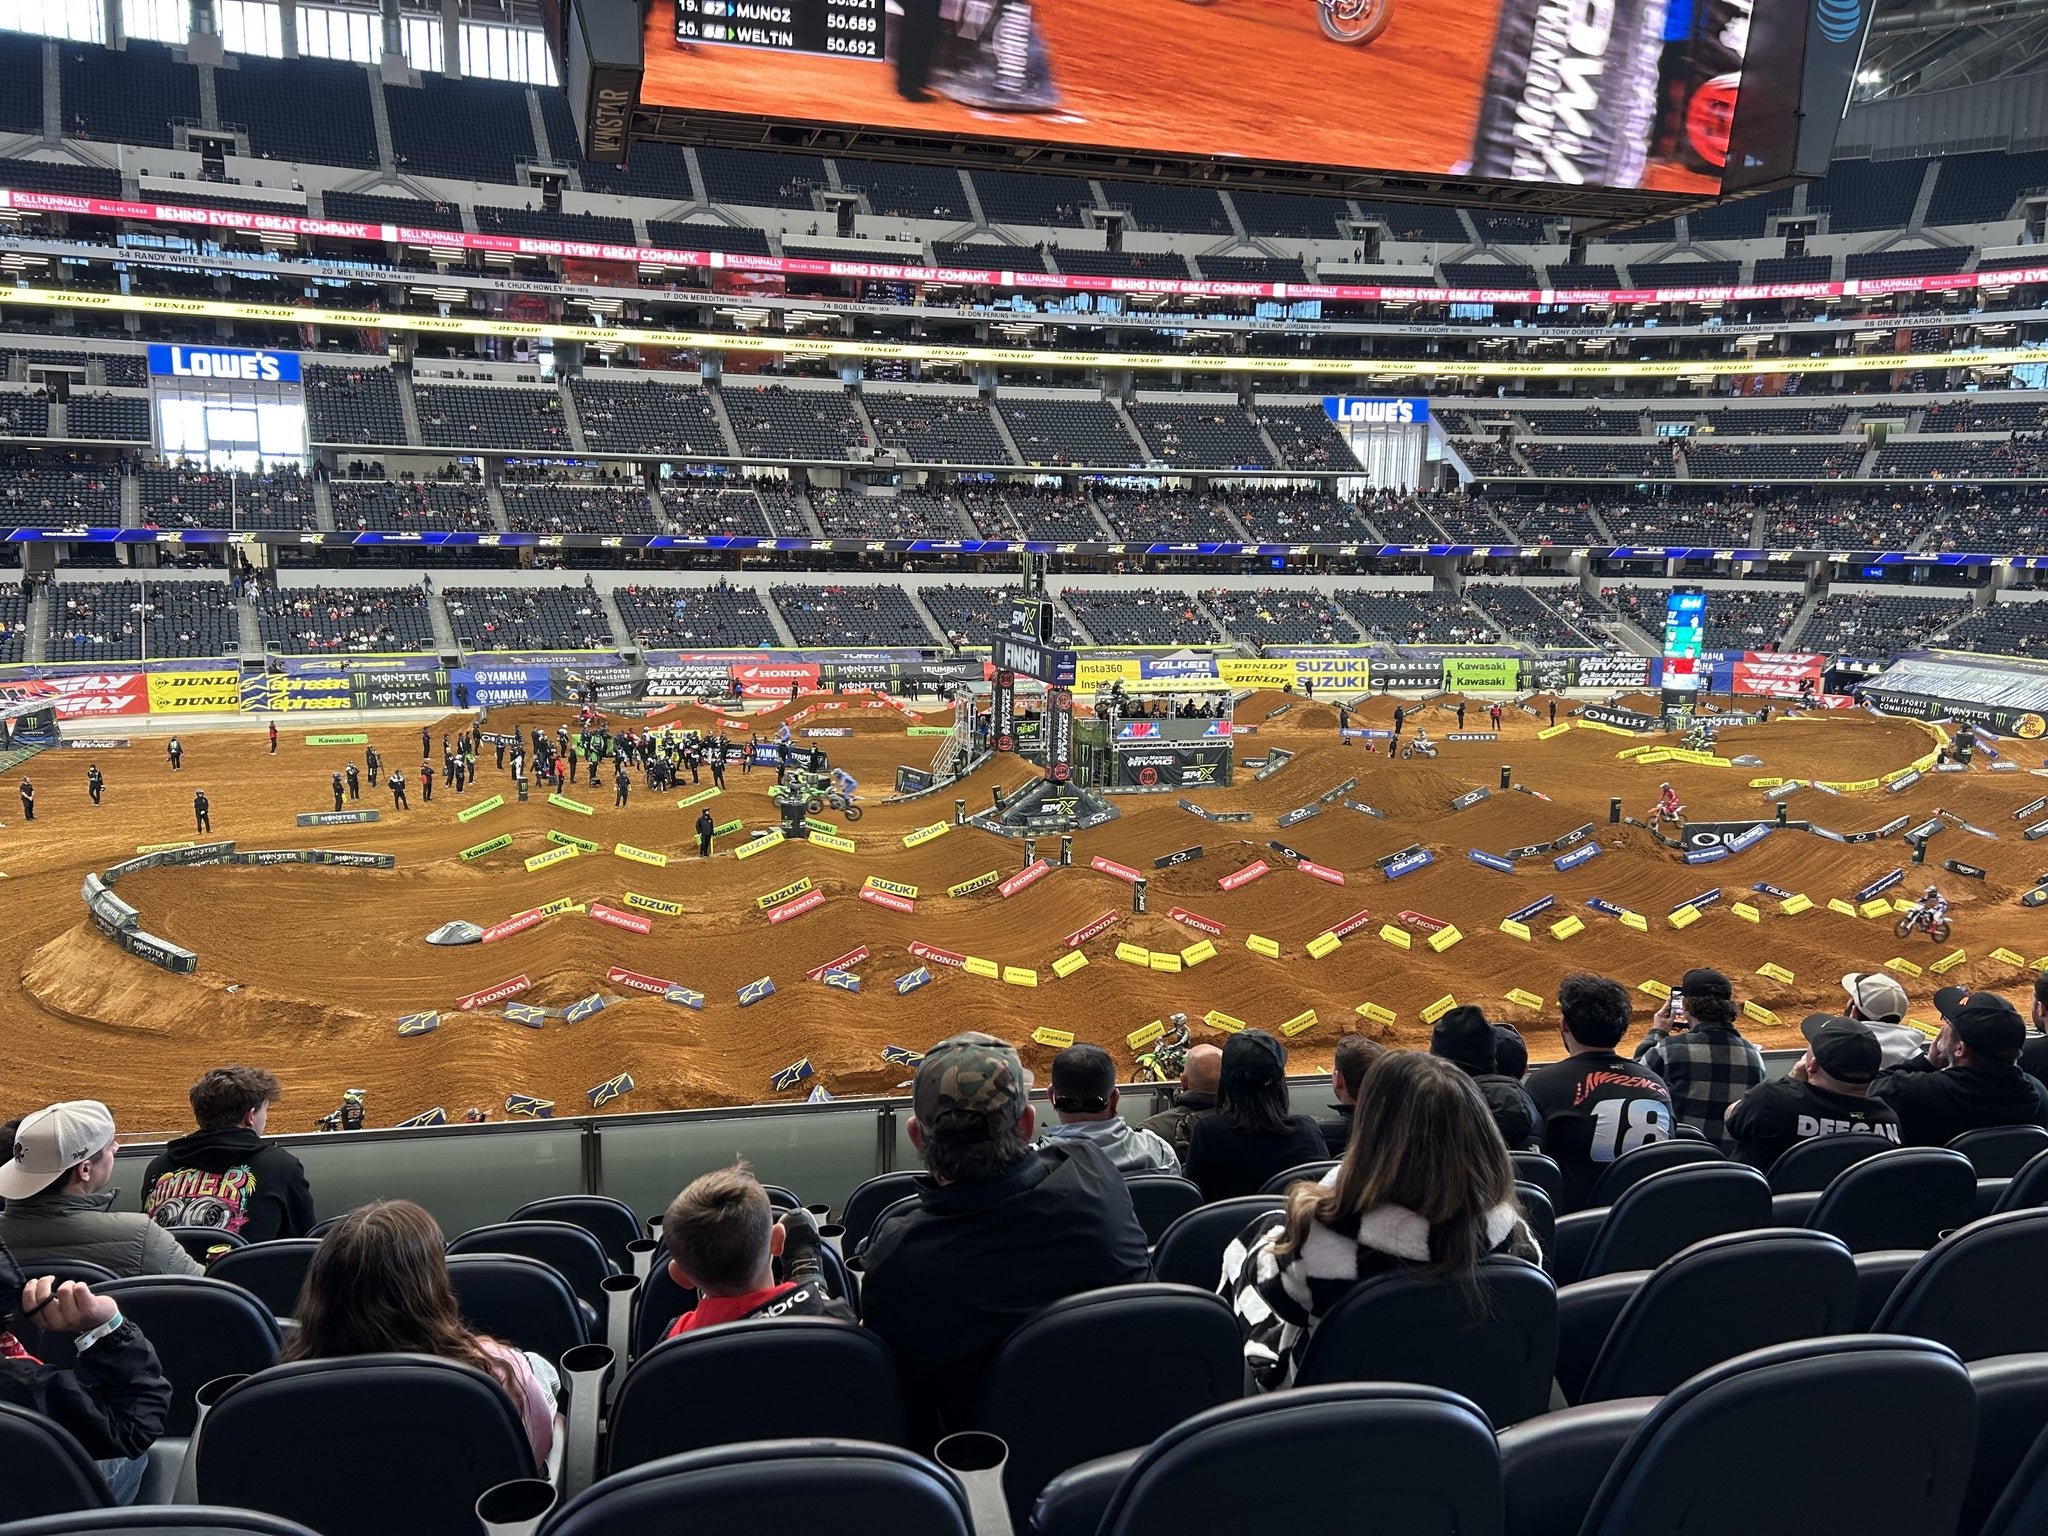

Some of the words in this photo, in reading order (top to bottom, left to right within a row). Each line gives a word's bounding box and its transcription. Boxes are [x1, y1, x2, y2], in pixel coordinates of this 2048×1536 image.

[736, 4, 792, 23] MUNOZ
[826, 14, 877, 32] 50.689
[736, 28, 794, 46] WELTIN
[826, 37, 876, 55] 50.692
[13, 192, 90, 208] BELLNUNNALLY
[156, 206, 206, 223] BEHIND
[209, 211, 252, 227] EVERY
[254, 216, 298, 232] GREAT
[400, 230, 465, 243] BELLNUNNALLY
[520, 240, 562, 254] BEHIND
[564, 243, 601, 257] EVERY
[602, 246, 638, 260] GREAT
[119, 250, 130, 258] 54
[134, 252, 166, 261] RANDY
[169, 254, 200, 264] WHITE
[337, 268, 353, 277] MEL
[355, 270, 388, 279] RENFRO
[830, 262, 868, 275] BEHIND
[870, 264, 902, 278] EVERY
[904, 268, 938, 280] GREAT
[1978, 271, 2022, 284] BEHIND
[508, 282, 532, 290] CHUCK
[534, 284, 563, 292] HOWLEY
[57, 294, 110, 304] DUNLOP
[690, 294, 725, 302] MEREDITH
[1380, 288, 1415, 299] BEHIND
[1417, 290, 1448, 300] EVERY
[1448, 290, 1480, 300] GREAT
[850, 304, 866, 312] LILLY
[968, 310, 981, 318] DON
[1130, 318, 1160, 326] STAUBACH
[1877, 318, 1901, 326] DREW
[1903, 316, 1942, 326] PEARSON
[1724, 325, 1762, 333] SCHRAMM
[1012, 606, 1036, 636] SMX
[1004, 642, 1040, 674] FINISH
[838, 666, 886, 674] MONSTER
[1080, 664, 1123, 674] Insta360
[1150, 660, 1210, 670] FALKEN
[1233, 662, 1288, 670] DUNLOP
[1296, 662, 1366, 672] SUZUKI
[1390, 662, 1440, 670] OAKLEY
[1456, 662, 1506, 671] Kawasaki
[371, 672, 430, 684] MONSTER
[487, 671, 527, 682] YAMAHA
[760, 670, 810, 678] HONDA
[1235, 675, 1289, 684] DUNLOP
[270, 677, 350, 693] alpinestars
[1296, 676, 1366, 688] SUZUKI
[1456, 677, 1506, 686] Kawasaki
[372, 692, 432, 702] MONSTER
[488, 690, 528, 700] YAMAHA
[271, 696, 350, 712] alpinestars
[1880, 696, 1899, 704] UTAH
[1901, 698, 1928, 708] SPORTS
[1666, 703, 1694, 716] SMX
[1880, 703, 1926, 716] COMMISSION
[1944, 706, 1991, 720] MONSTER
[1600, 712, 1647, 728] OAKLEY
[1690, 716, 1744, 726] MONSTER
[2026, 712, 2040, 723] Bass
[1016, 722, 1038, 735] BEAST
[2024, 721, 2037, 730] Pro
[2024, 726, 2041, 736] Shops
[318, 736, 354, 744] Kawasaki
[1182, 767, 1216, 780] SMX
[682, 788, 717, 806] Kawasaki
[462, 798, 498, 818] Kawasaki
[553, 796, 590, 812] Kawasaki
[1041, 800, 1077, 815] SMX
[320, 812, 358, 822] MONSTER
[906, 824, 946, 844] SUZUKI
[1734, 827, 1764, 847] FALKEN
[466, 838, 508, 859] Kawasaki
[738, 832, 780, 855] SUZUKI
[813, 834, 854, 850] SUZUKI
[183, 845, 218, 856] MONSTER
[258, 852, 298, 862] MONSTER
[528, 845, 575, 868] SUZUKI
[620, 845, 664, 863] SUZUKI
[1562, 846, 1594, 866] FALKEN
[334, 855, 374, 864] MONSTER
[1392, 852, 1428, 871] FALKEN
[1012, 863, 1046, 888] HONDA
[1105, 863, 1140, 881] HONDA
[870, 878, 916, 896] SUZUKI
[952, 874, 997, 896] SUZUKI
[782, 894, 822, 917] HONDA
[496, 912, 540, 935] HONDA
[605, 912, 648, 932] HONDA
[1080, 914, 1119, 942] HONDA
[1184, 916, 1222, 936] HONDA
[132, 940, 165, 960] MONSTER
[475, 981, 526, 1006] HONDA
[1590, 1098, 1670, 1162] 18
[148, 1168, 246, 1208] SUMMER
